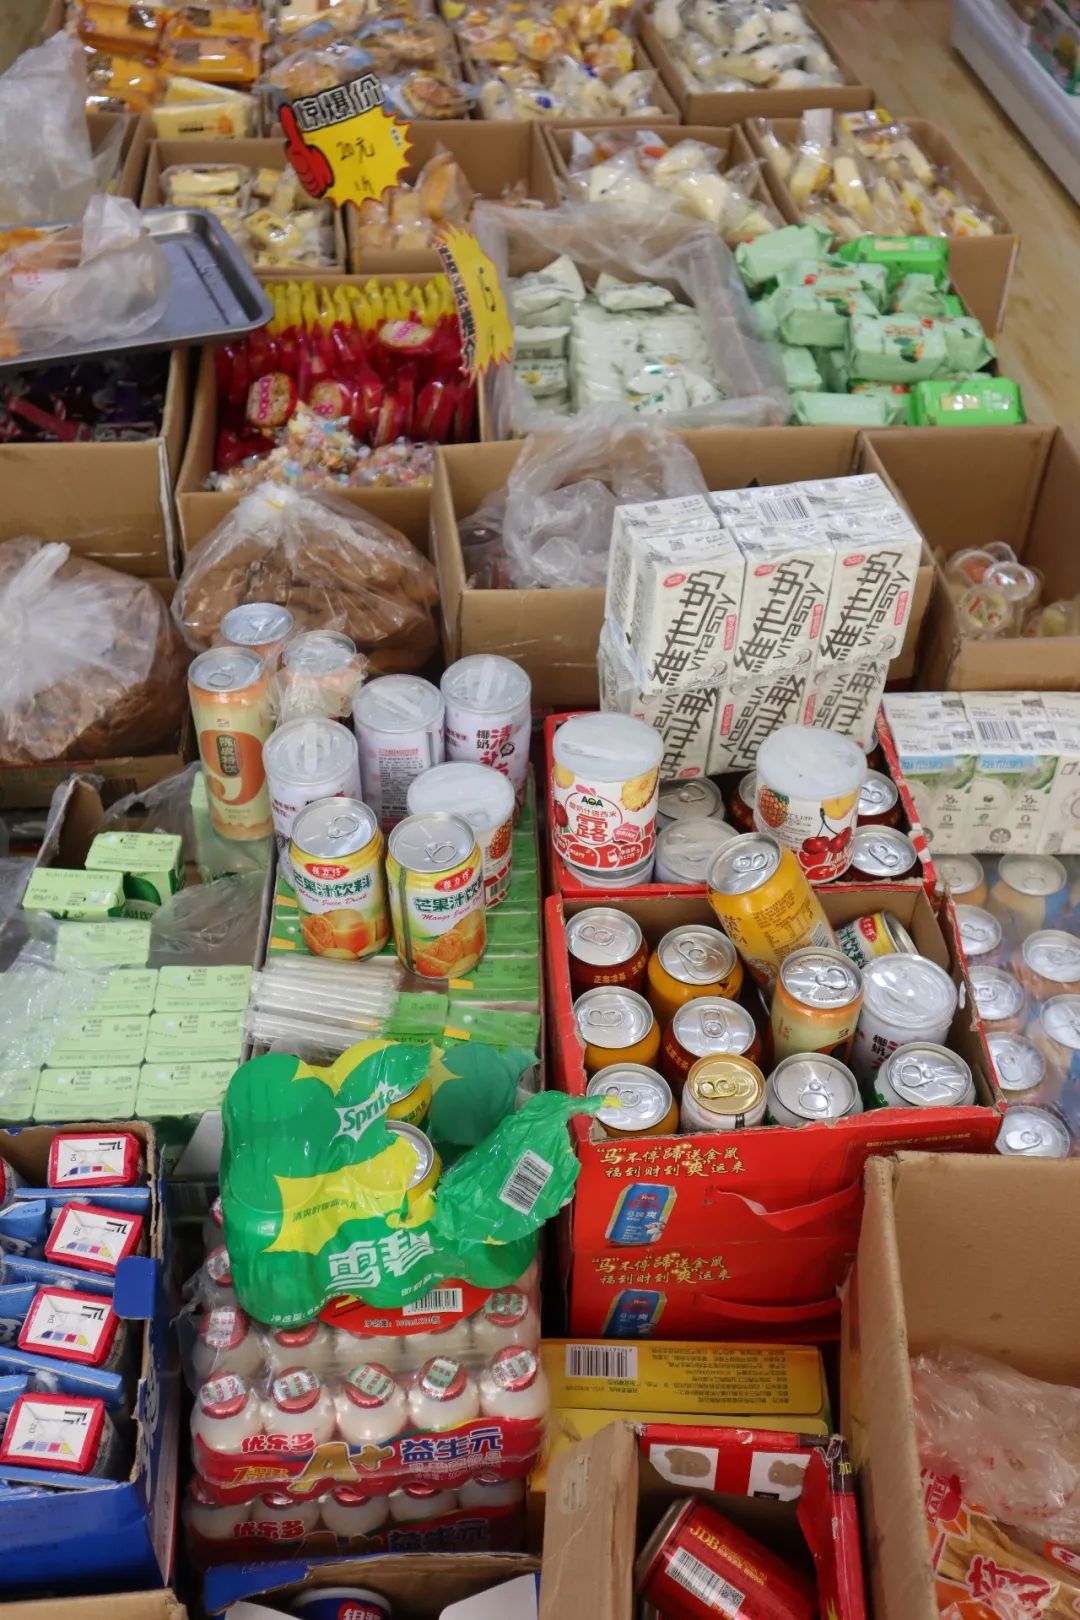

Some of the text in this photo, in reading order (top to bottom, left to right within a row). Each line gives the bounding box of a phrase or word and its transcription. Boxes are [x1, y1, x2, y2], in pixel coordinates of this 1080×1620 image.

[652, 694, 680, 730] vita
[293, 868, 374, 898] 芒果汁饮料
[343, 1089, 395, 1132] Sprite
[326, 1229, 437, 1290] 雪碧
[241, 1433, 316, 1453] 优乐多
[401, 1426, 503, 1465] 益生元
[232, 1519, 305, 1540] 优乐多
[689, 1526, 720, 1550] JDB
